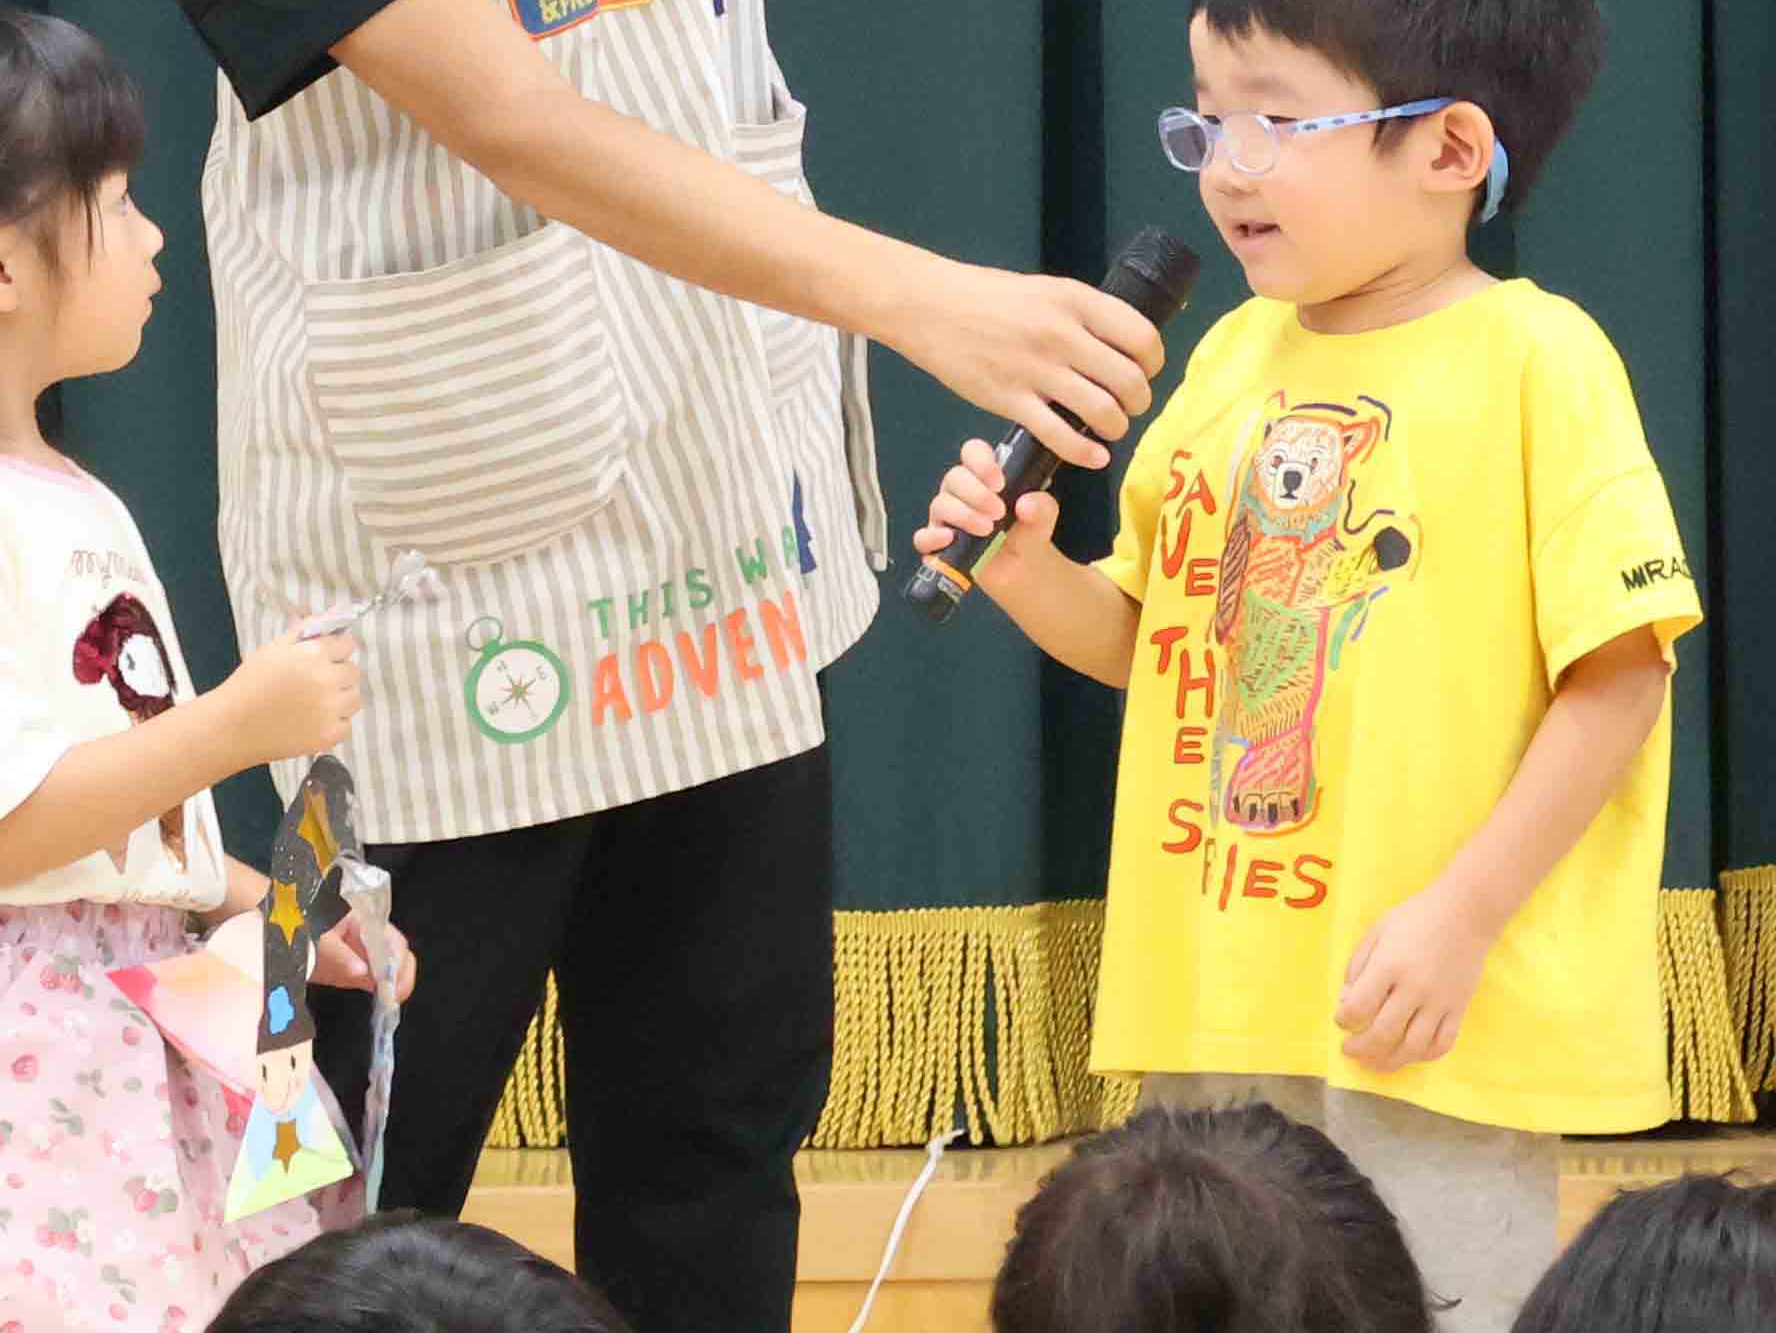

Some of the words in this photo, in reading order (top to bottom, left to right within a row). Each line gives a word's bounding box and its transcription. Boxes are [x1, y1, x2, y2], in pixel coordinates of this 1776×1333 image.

[1159, 449, 1218, 598] SAVE
[587, 567, 718, 639] THIS
[591, 589, 809, 726] ADVEN
[1150, 625, 1216, 767] THE
